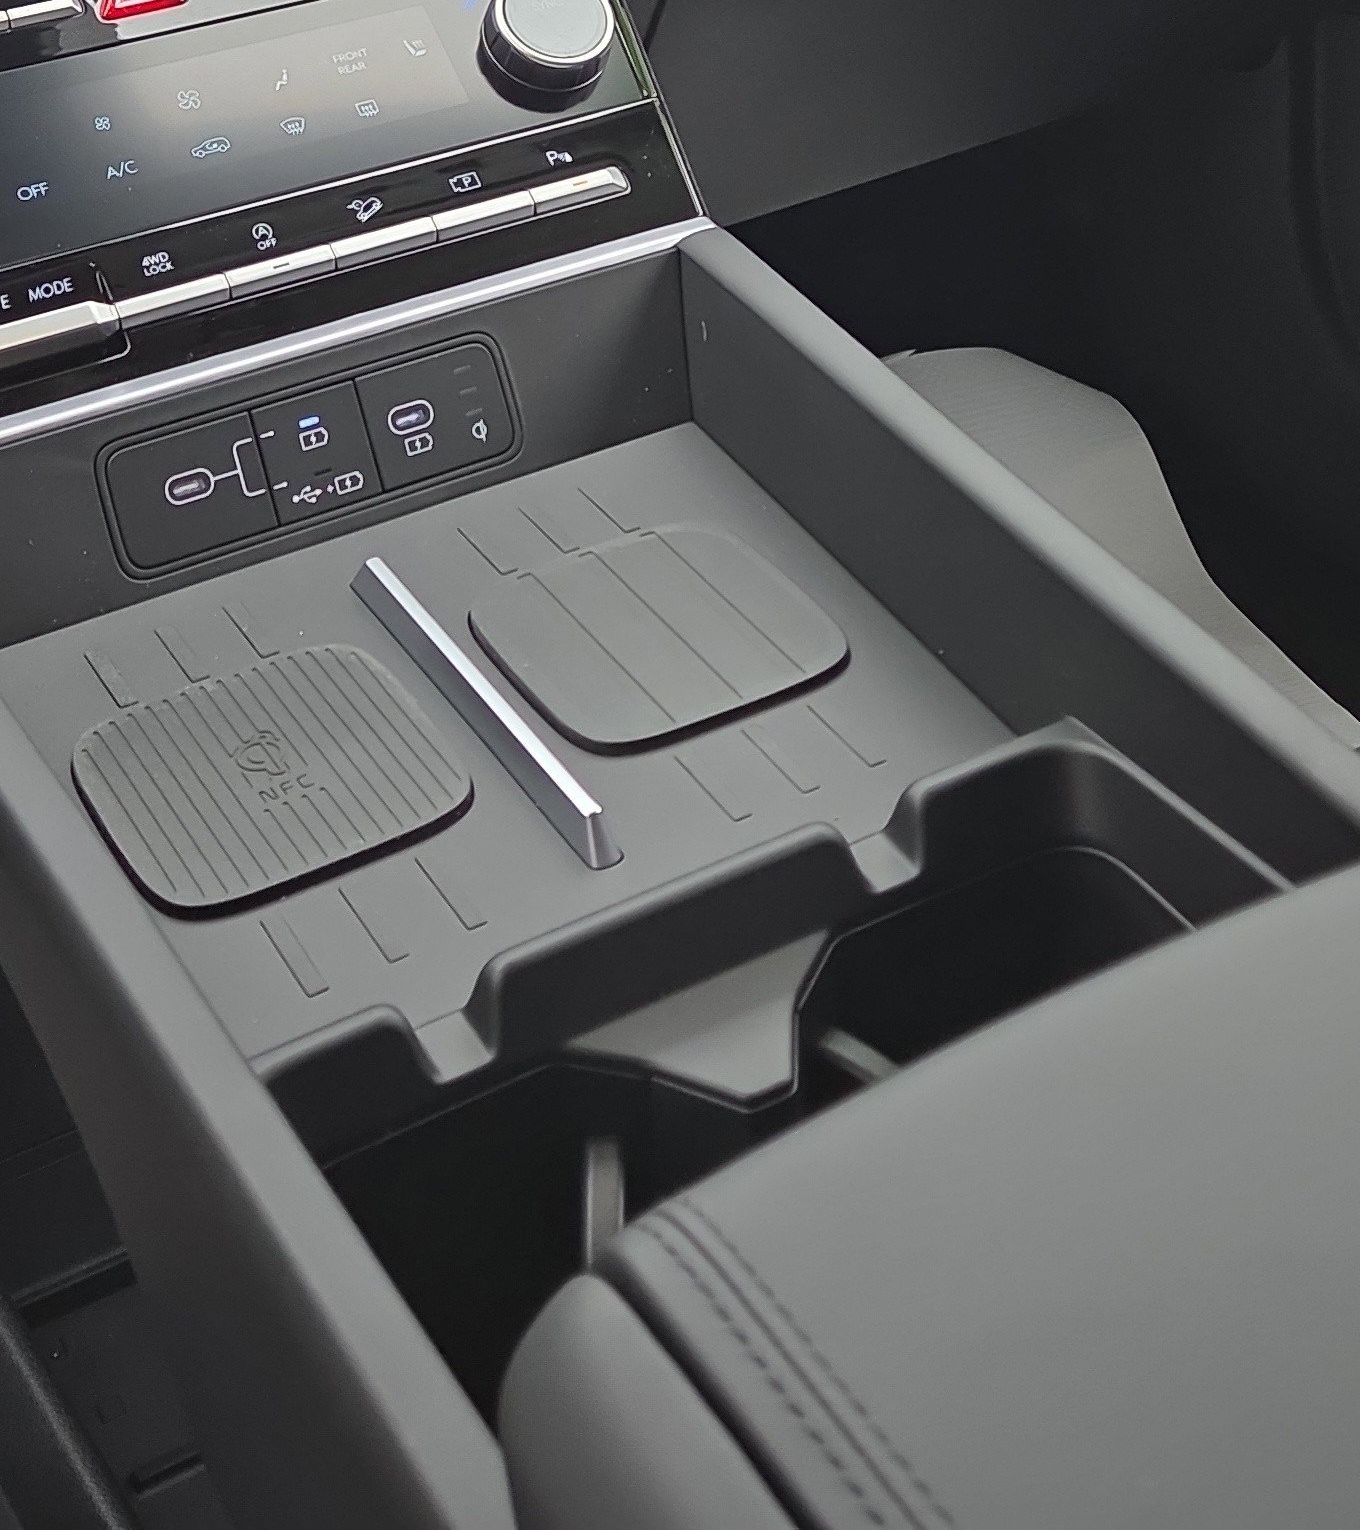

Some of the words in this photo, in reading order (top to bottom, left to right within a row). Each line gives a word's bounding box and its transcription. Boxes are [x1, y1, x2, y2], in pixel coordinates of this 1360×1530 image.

[332, 47, 367, 63] FRONT
[337, 62, 367, 75] REAR
[106, 160, 139, 179] A/C
[16, 181, 49, 202] OFF
[257, 237, 277, 250] OFF
[141, 251, 169, 267] 4WD
[143, 261, 175, 277] LOCK
[28, 277, 74, 303] MODE
[259, 773, 315, 803] NFC
